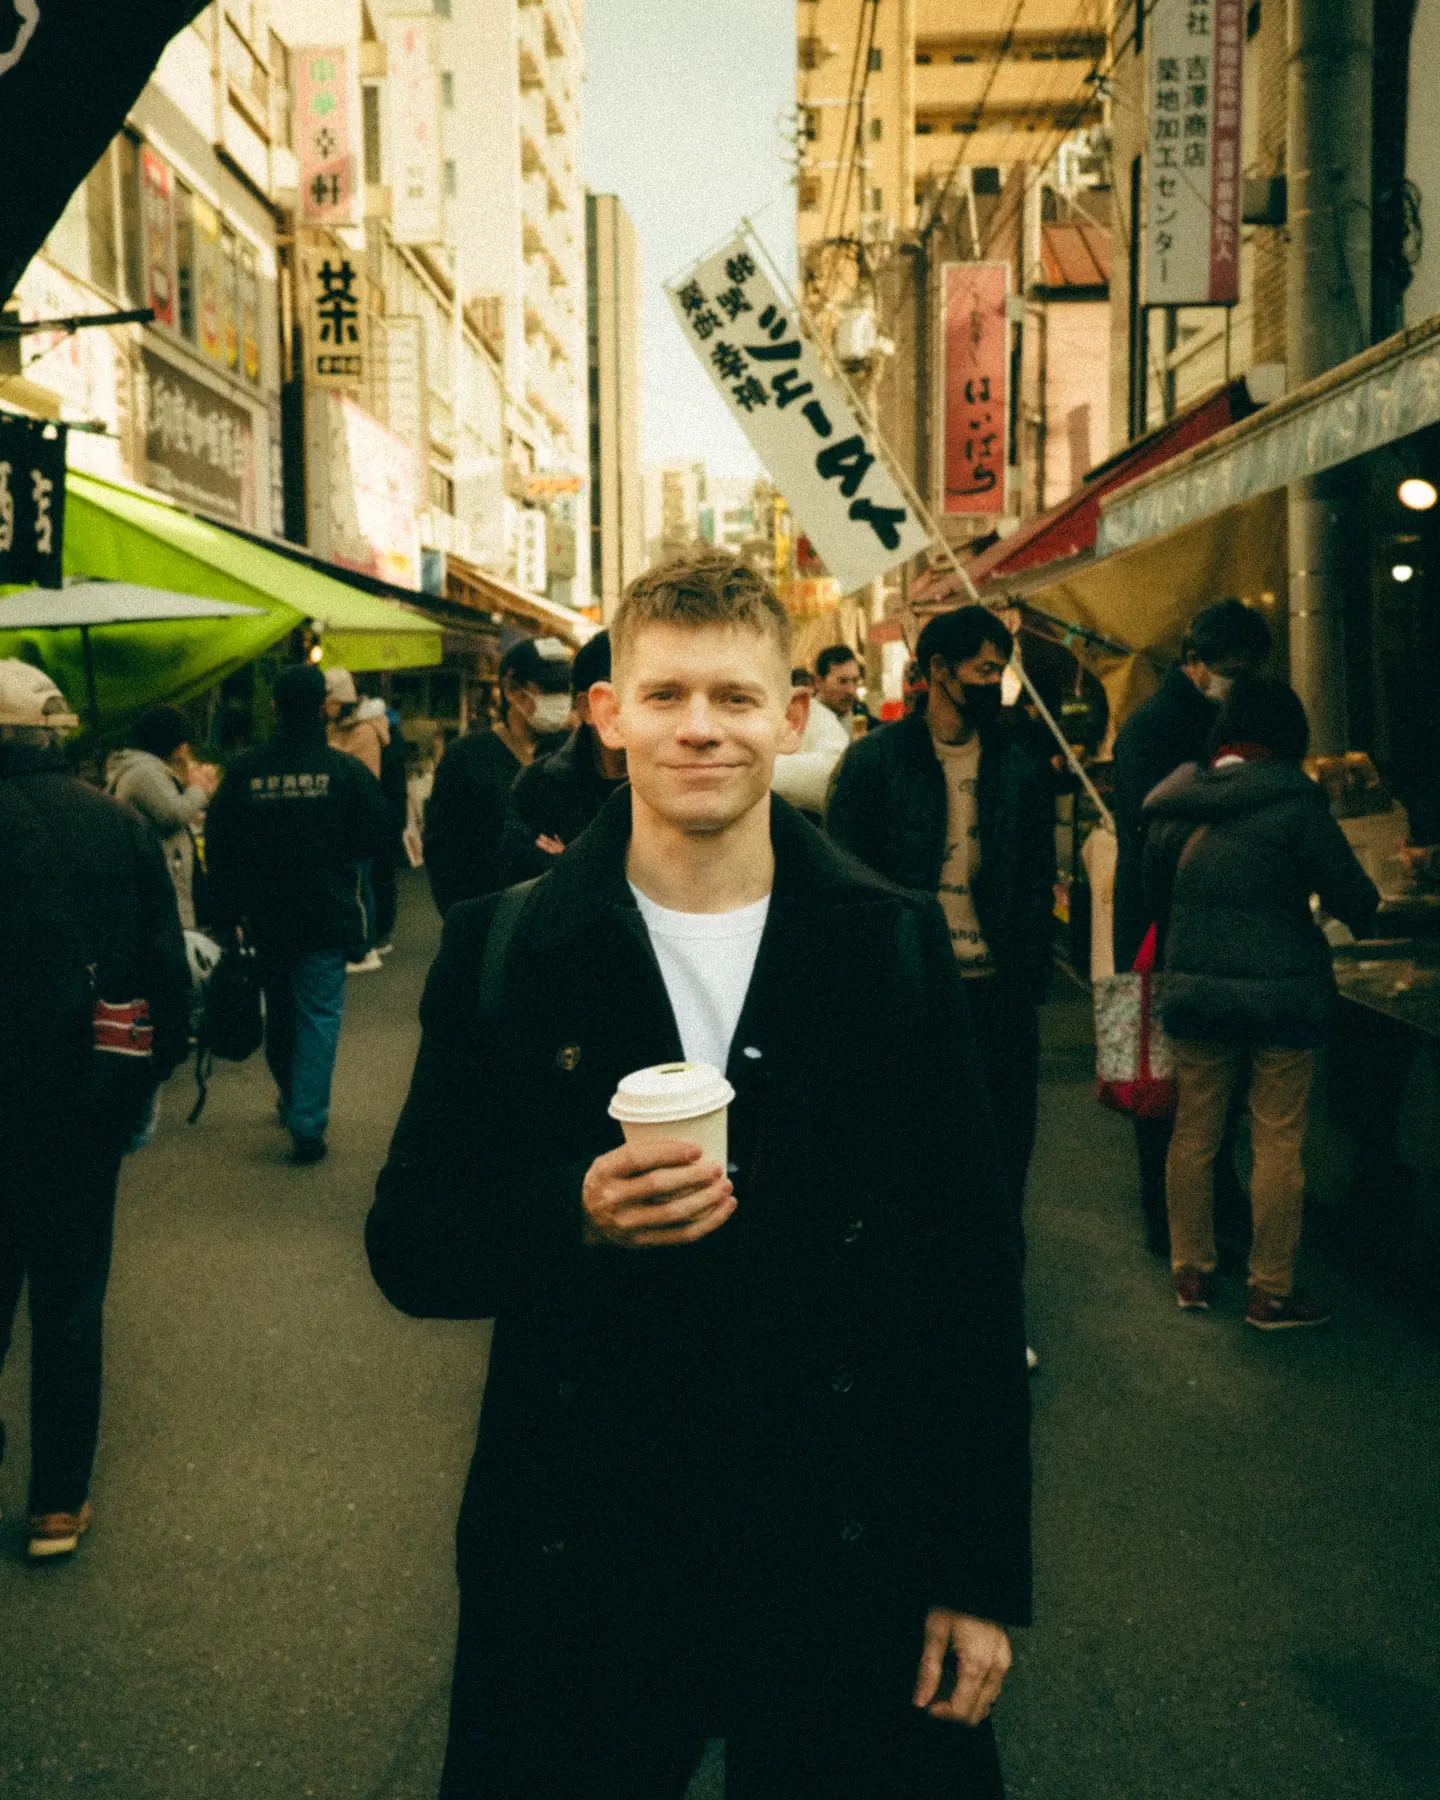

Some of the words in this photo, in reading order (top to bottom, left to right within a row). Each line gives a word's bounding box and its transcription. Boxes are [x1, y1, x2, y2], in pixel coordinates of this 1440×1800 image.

[1154, 57, 1180, 282] 築地加工センター
[317, 260, 358, 344] 茶
